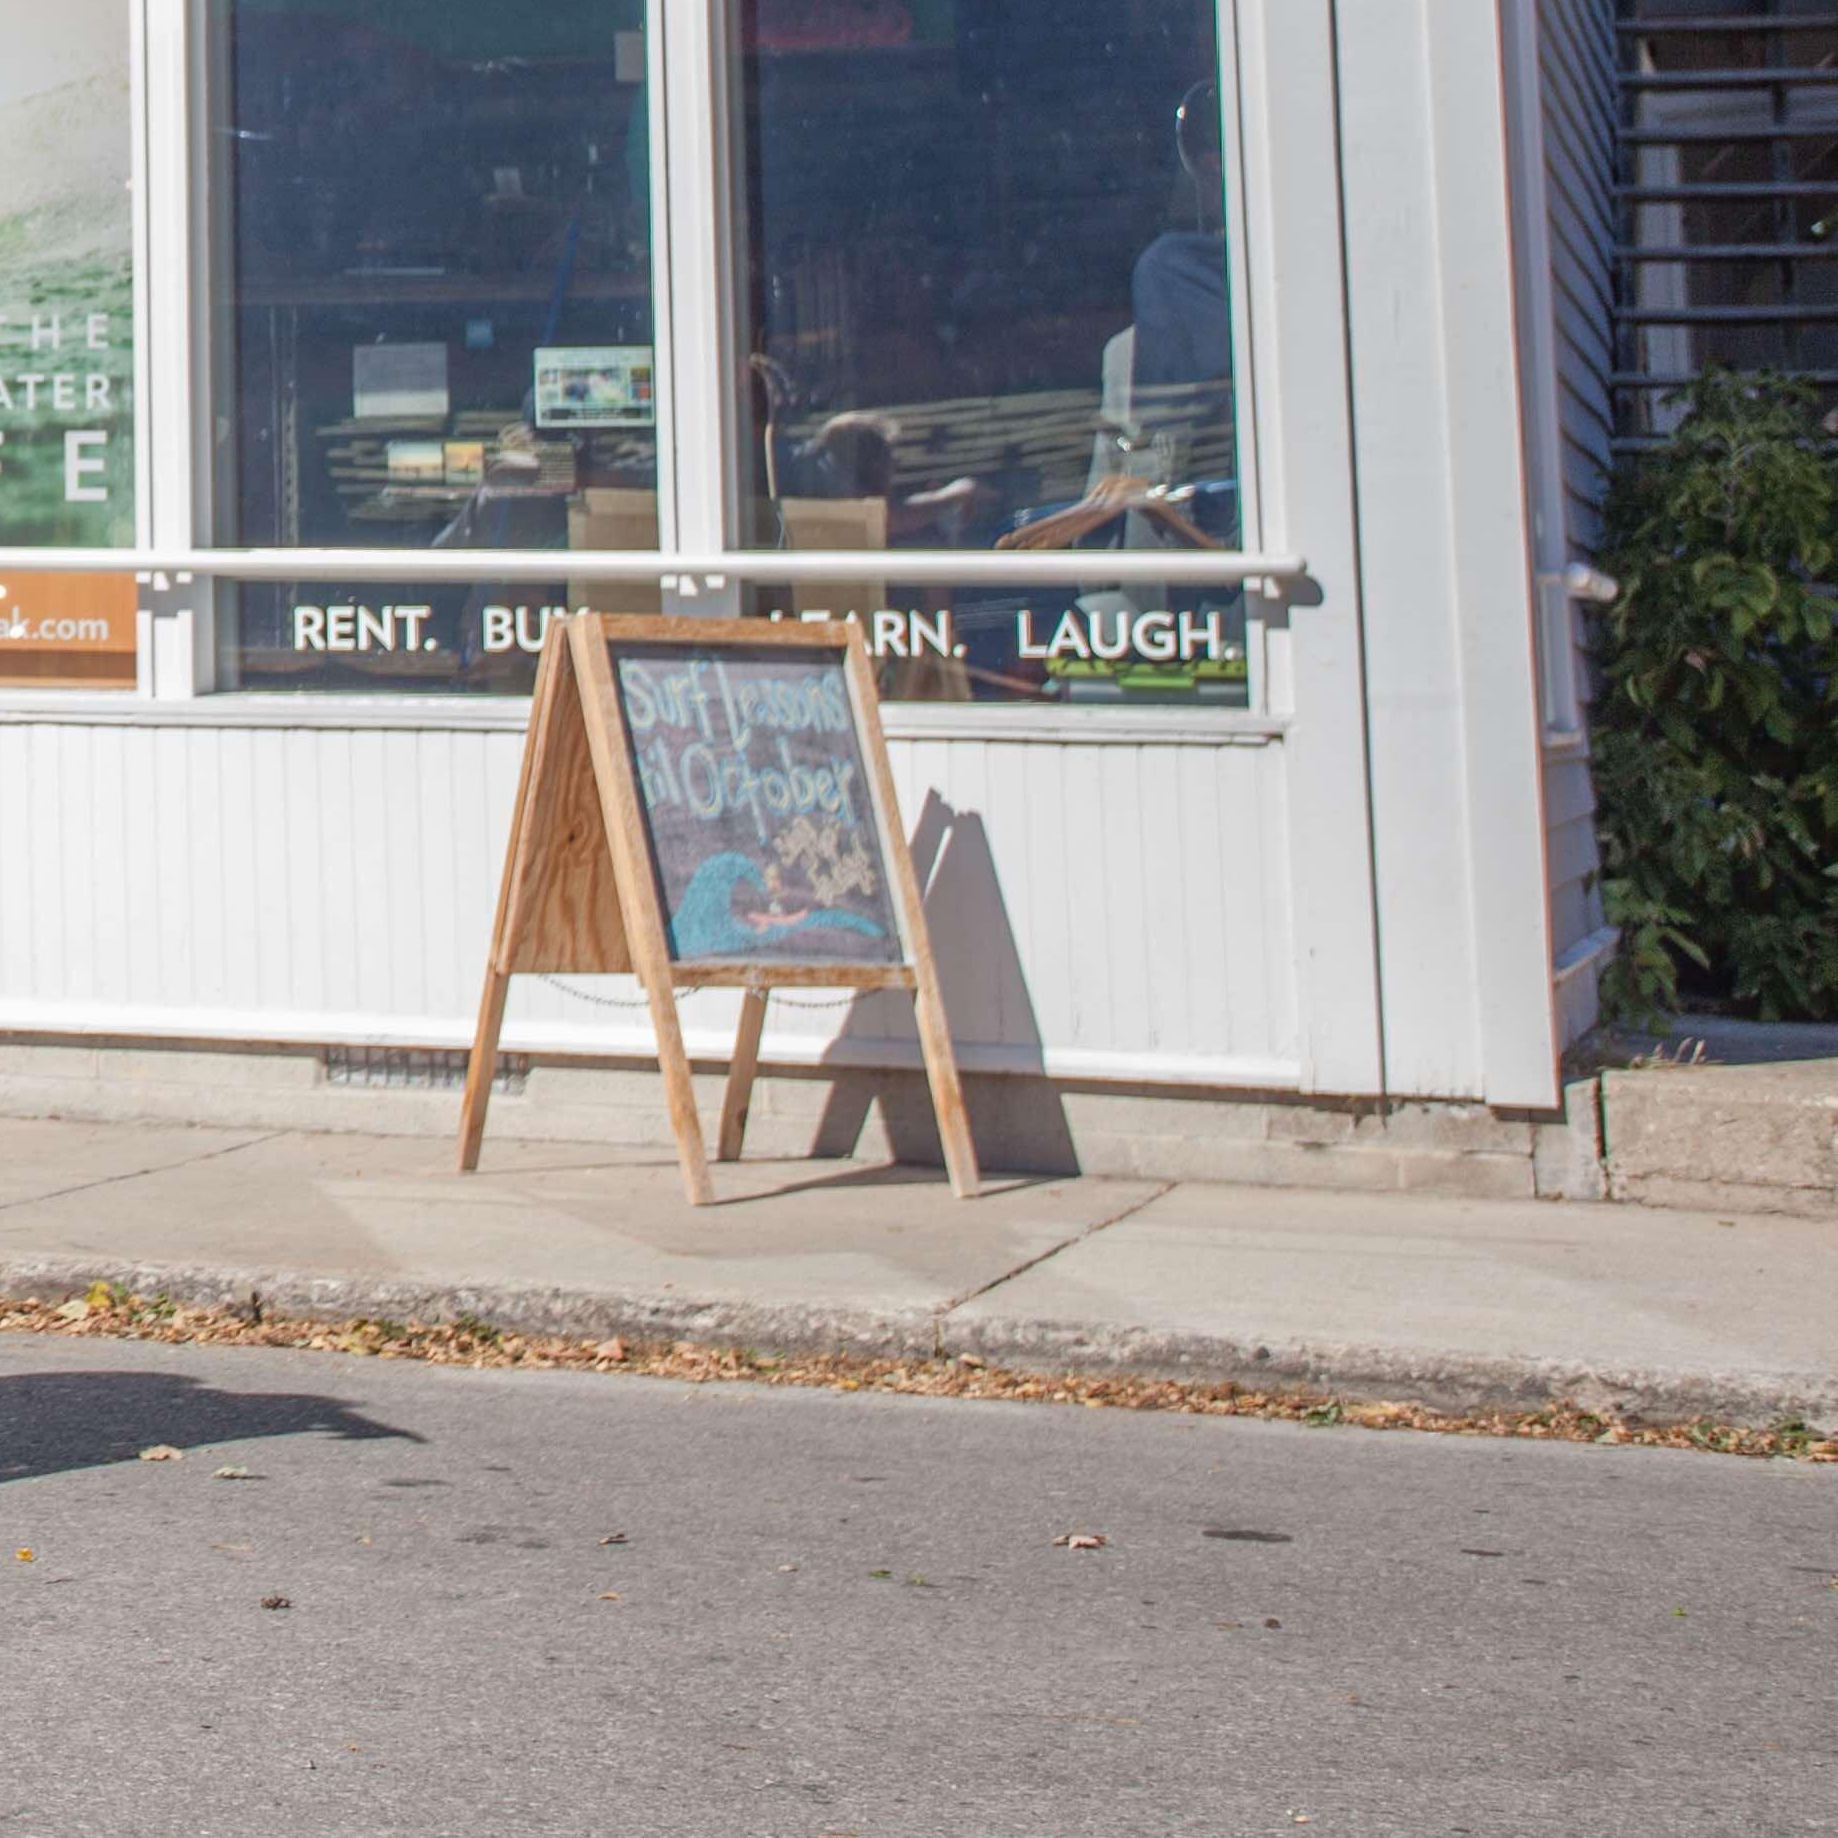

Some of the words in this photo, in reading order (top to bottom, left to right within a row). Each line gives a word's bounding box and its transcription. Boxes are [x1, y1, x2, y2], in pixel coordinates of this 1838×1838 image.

[292, 605, 438, 652] RENT.
[769, 609, 969, 659] RN.
[1016, 609, 1237, 661] LAUGH.
[618, 657, 714, 743] Surf
[680, 735, 859, 846] October
